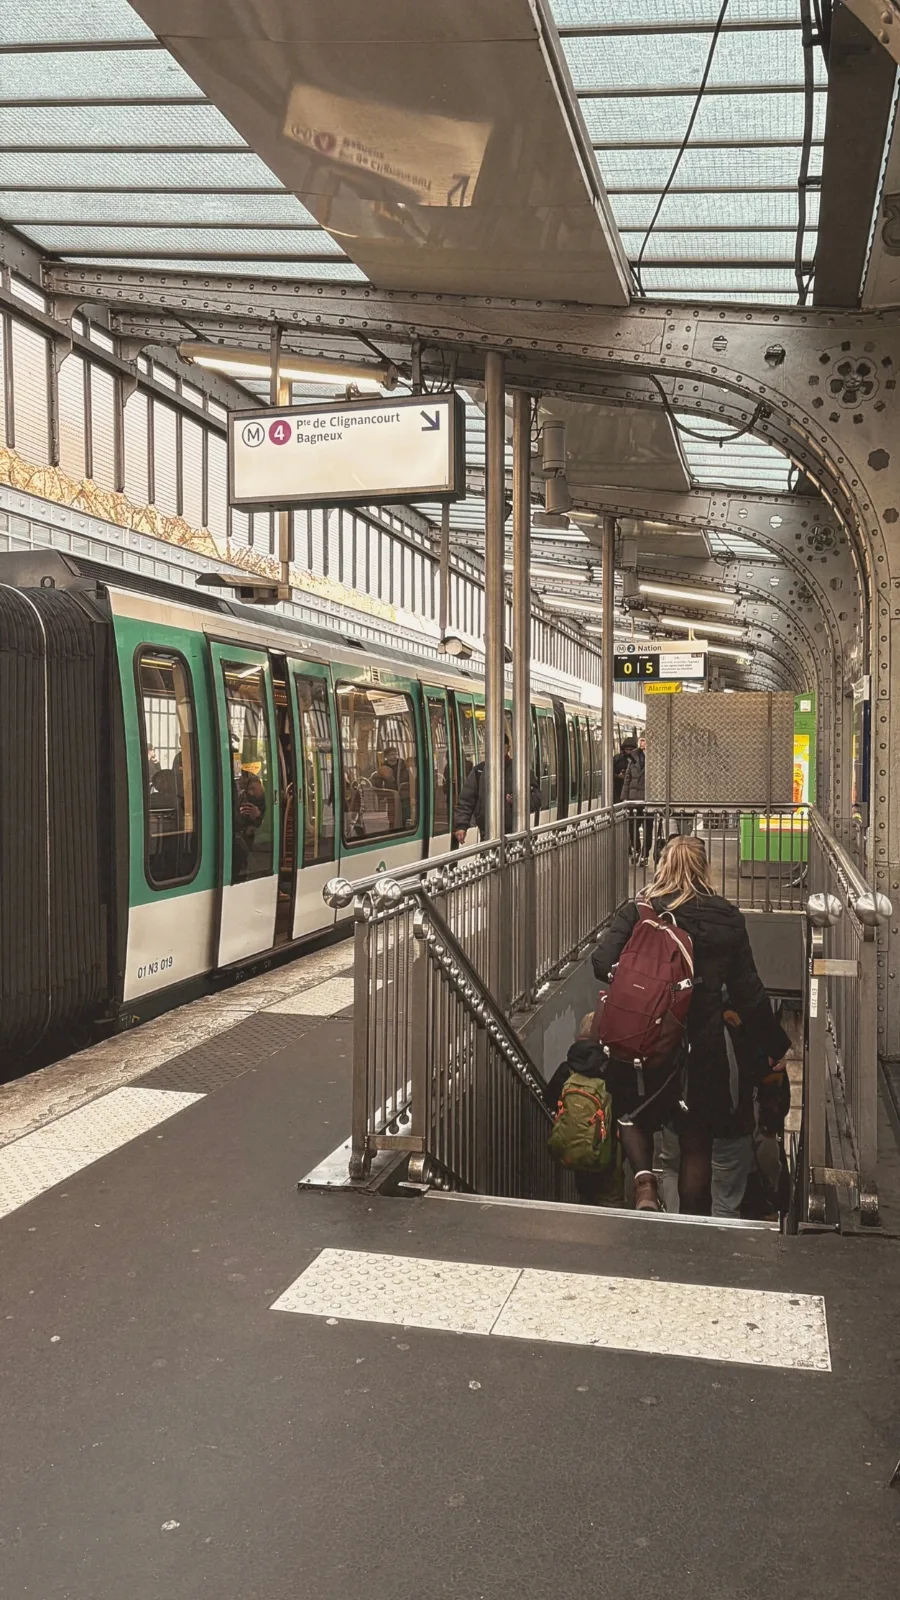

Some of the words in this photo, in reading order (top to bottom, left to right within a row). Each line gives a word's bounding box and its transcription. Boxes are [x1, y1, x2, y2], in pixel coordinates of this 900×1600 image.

[313, 417, 326, 429] de
[330, 412, 401, 428] Clignancourt
[297, 431, 343, 445] Bagneux
[637, 644, 662, 652] Nation
[623, 662, 633, 674] 0
[645, 662, 653, 674] 5
[137, 965, 147, 979] 01
[148, 961, 159, 976] N3
[160, 956, 173, 971] 019
